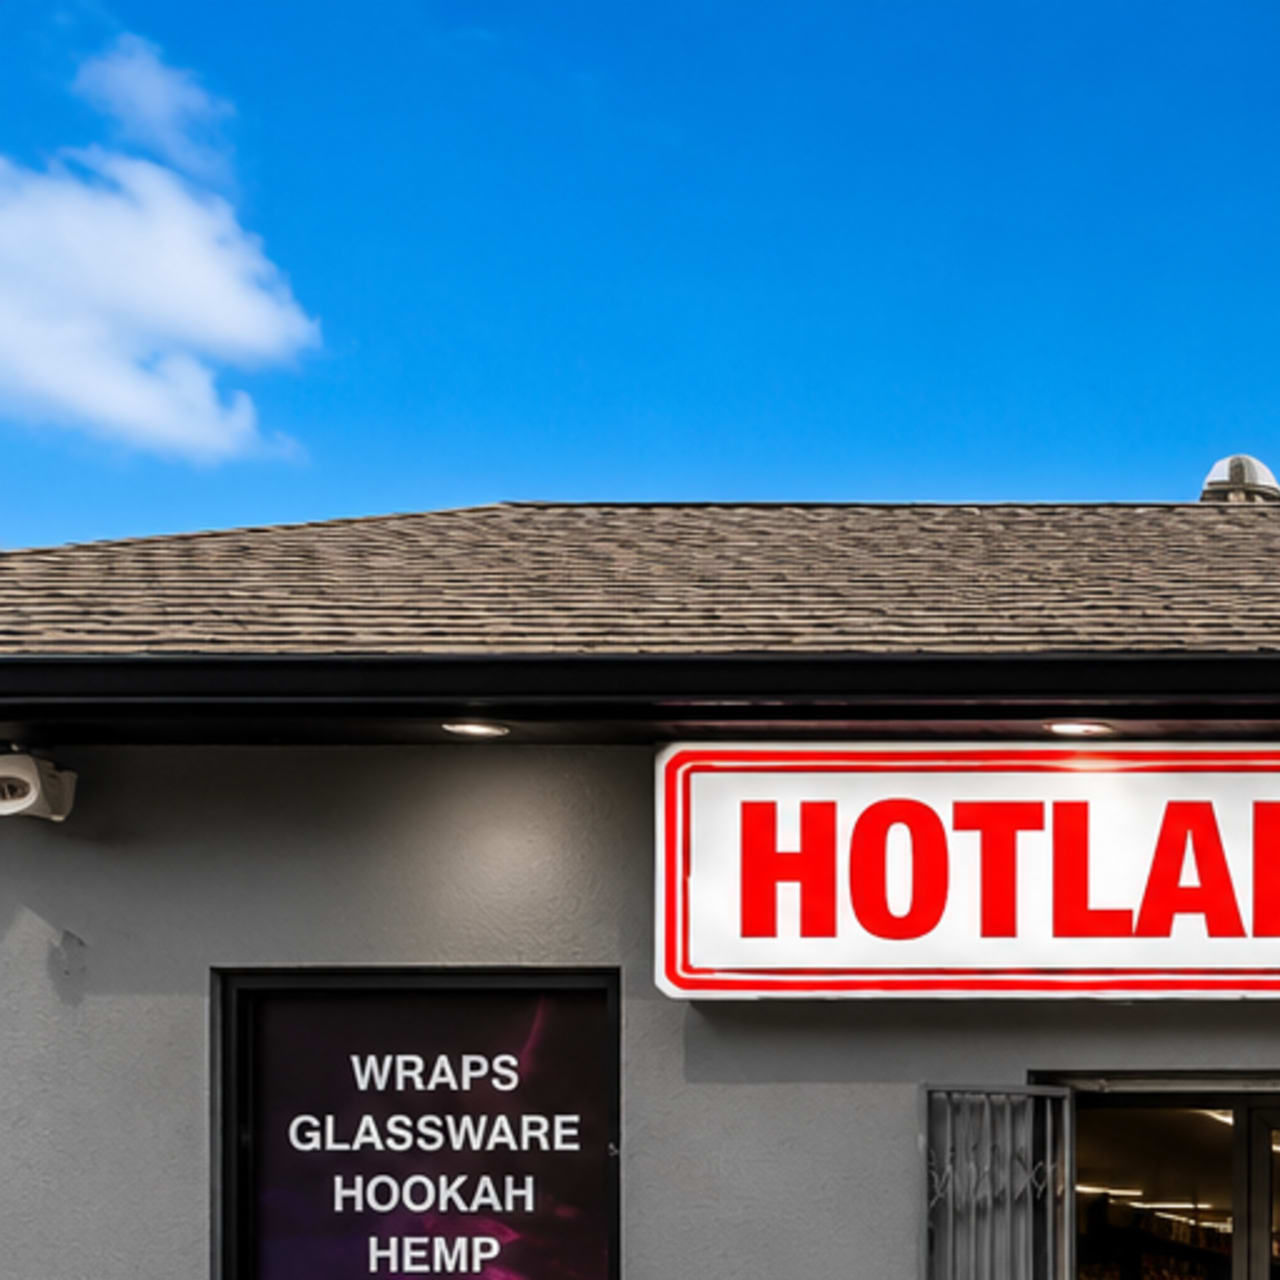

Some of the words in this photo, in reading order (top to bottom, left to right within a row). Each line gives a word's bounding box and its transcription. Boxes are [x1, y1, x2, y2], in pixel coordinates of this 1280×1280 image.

[351, 1054, 519, 1091] WRAPS
[289, 1114, 580, 1151] GLASSWARE
[334, 1175, 534, 1212] HOOKAH
[369, 1236, 500, 1273] HEMP
